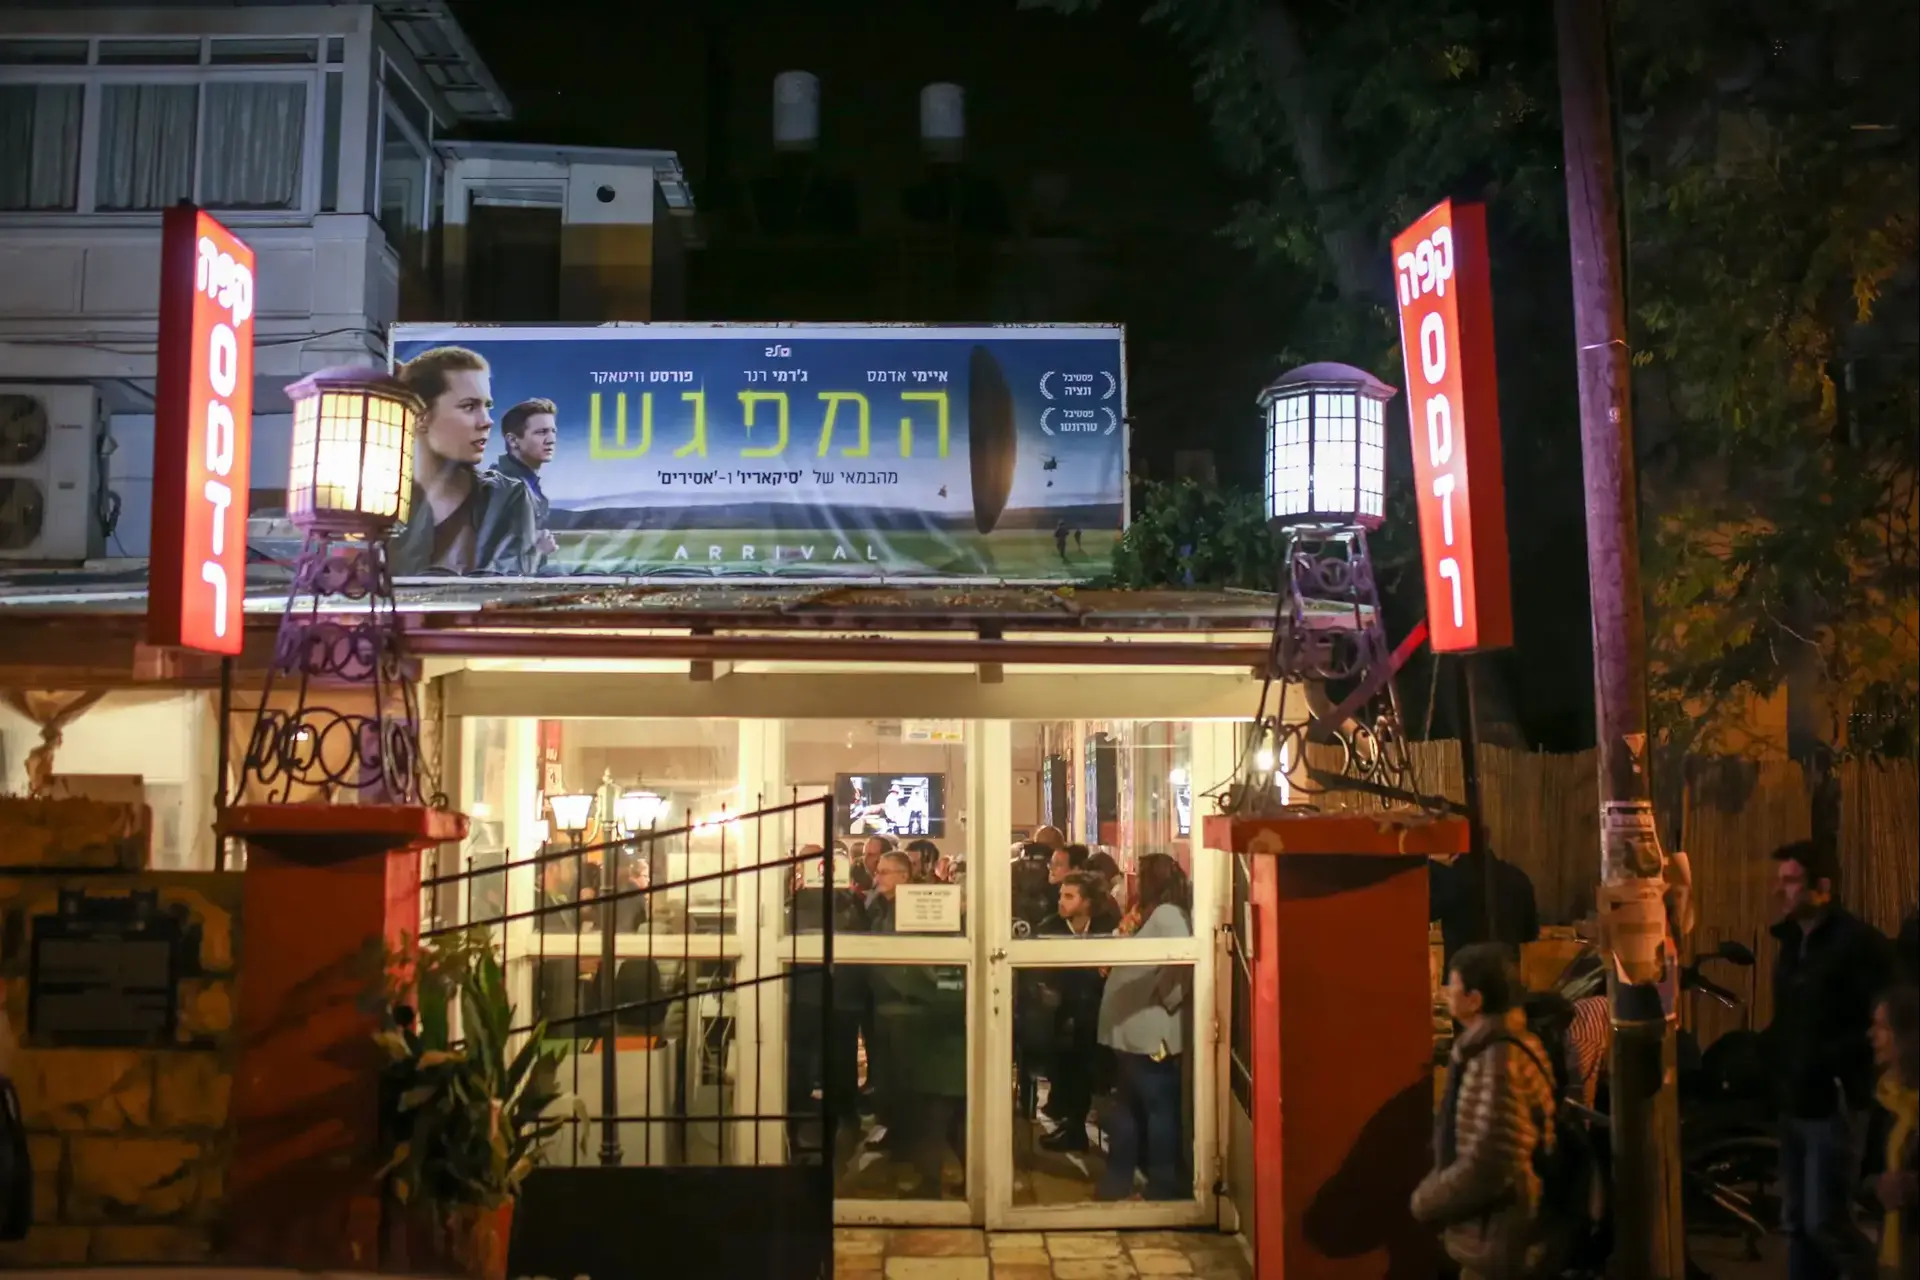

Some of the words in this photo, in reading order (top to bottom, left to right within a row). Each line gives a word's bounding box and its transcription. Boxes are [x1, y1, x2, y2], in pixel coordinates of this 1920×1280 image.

[1398, 226, 1453, 306] קפה
[197, 236, 253, 328] קפה
[590, 371, 645, 384] וויטאקר
[650, 371, 693, 382] פורסט
[743, 370, 767, 382] רנר
[772, 368, 808, 382] ג'רמי
[866, 370, 907, 382] אדמס
[912, 370, 948, 382] איימי
[1062, 373, 1093, 382] פסטיבל
[1064, 386, 1092, 396] ונציה
[1062, 409, 1094, 418] פסטיבל
[590, 390, 948, 459] המפגש
[1060, 423, 1098, 432] טורונטו
[1420, 312, 1463, 627] סמדר
[202, 323, 237, 638] סמדר
[812, 469, 834, 484] של
[840, 471, 898, 484] מהבמאי
[674, 545, 878, 561] ARRIVAL
